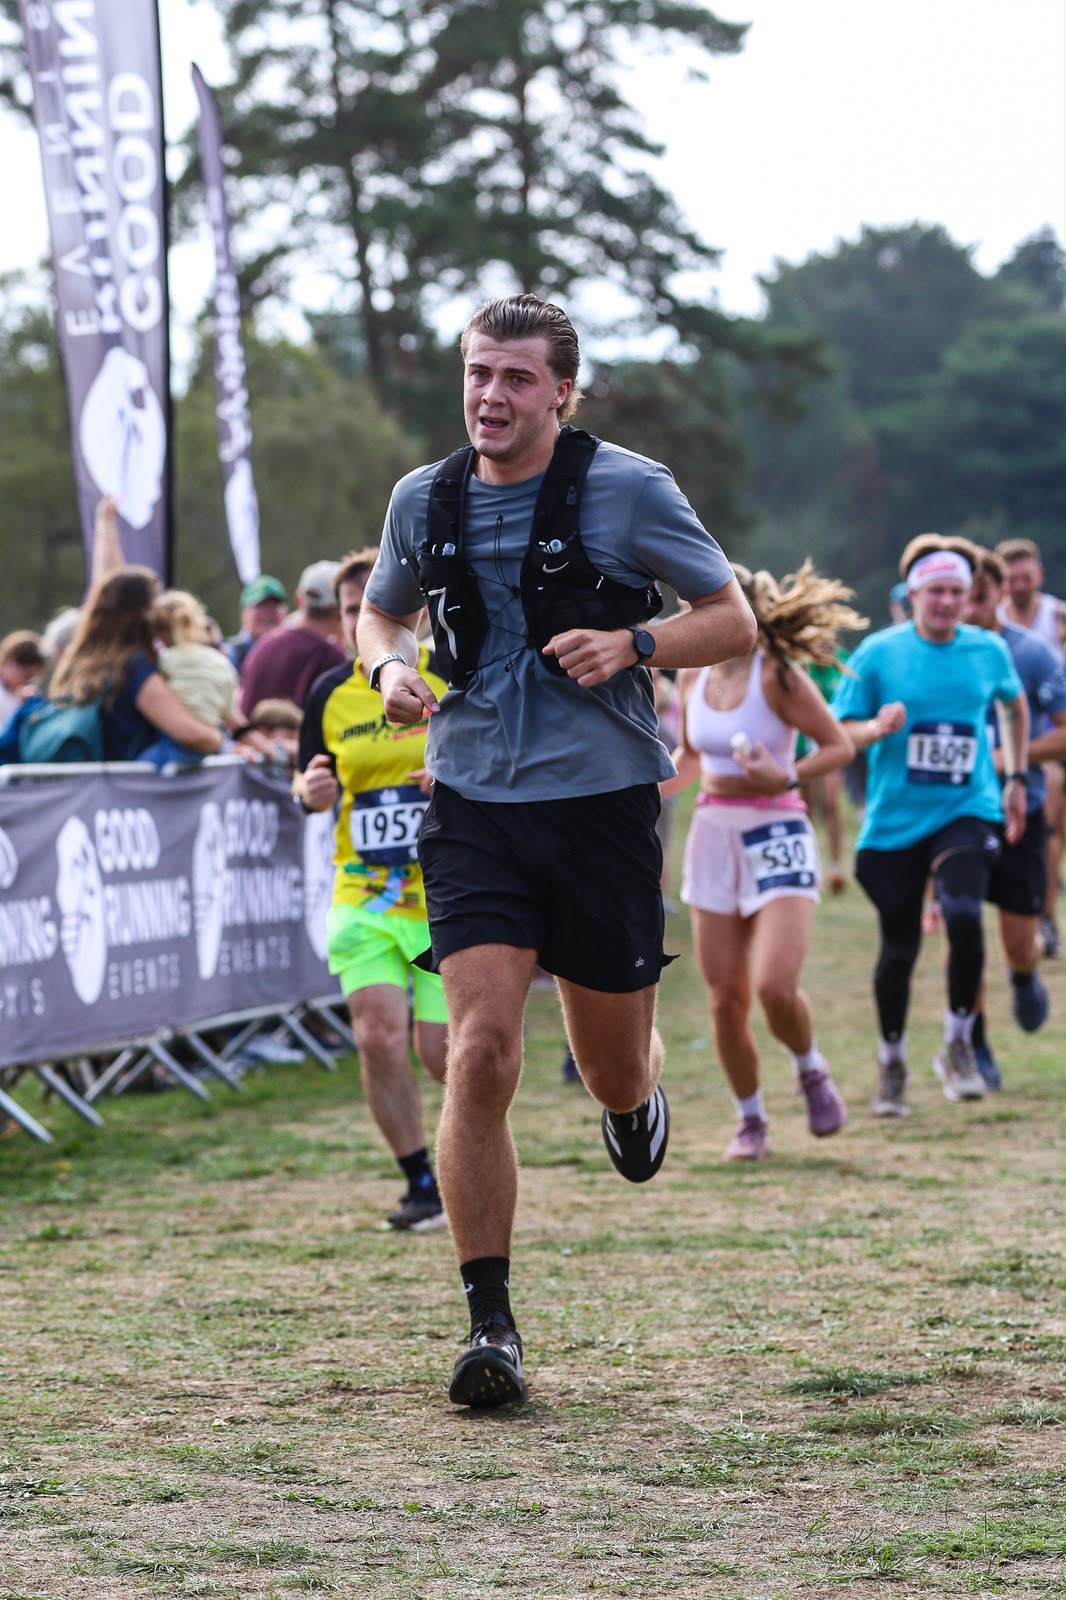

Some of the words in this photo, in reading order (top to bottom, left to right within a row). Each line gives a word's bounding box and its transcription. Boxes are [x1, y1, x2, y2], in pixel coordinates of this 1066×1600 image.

[917, 740, 972, 766] 1809
[94, 808, 161, 873] GOOD
[362, 807, 426, 846] 1952
[761, 839, 807, 871] 530
[102, 875, 192, 947] RUNNING
